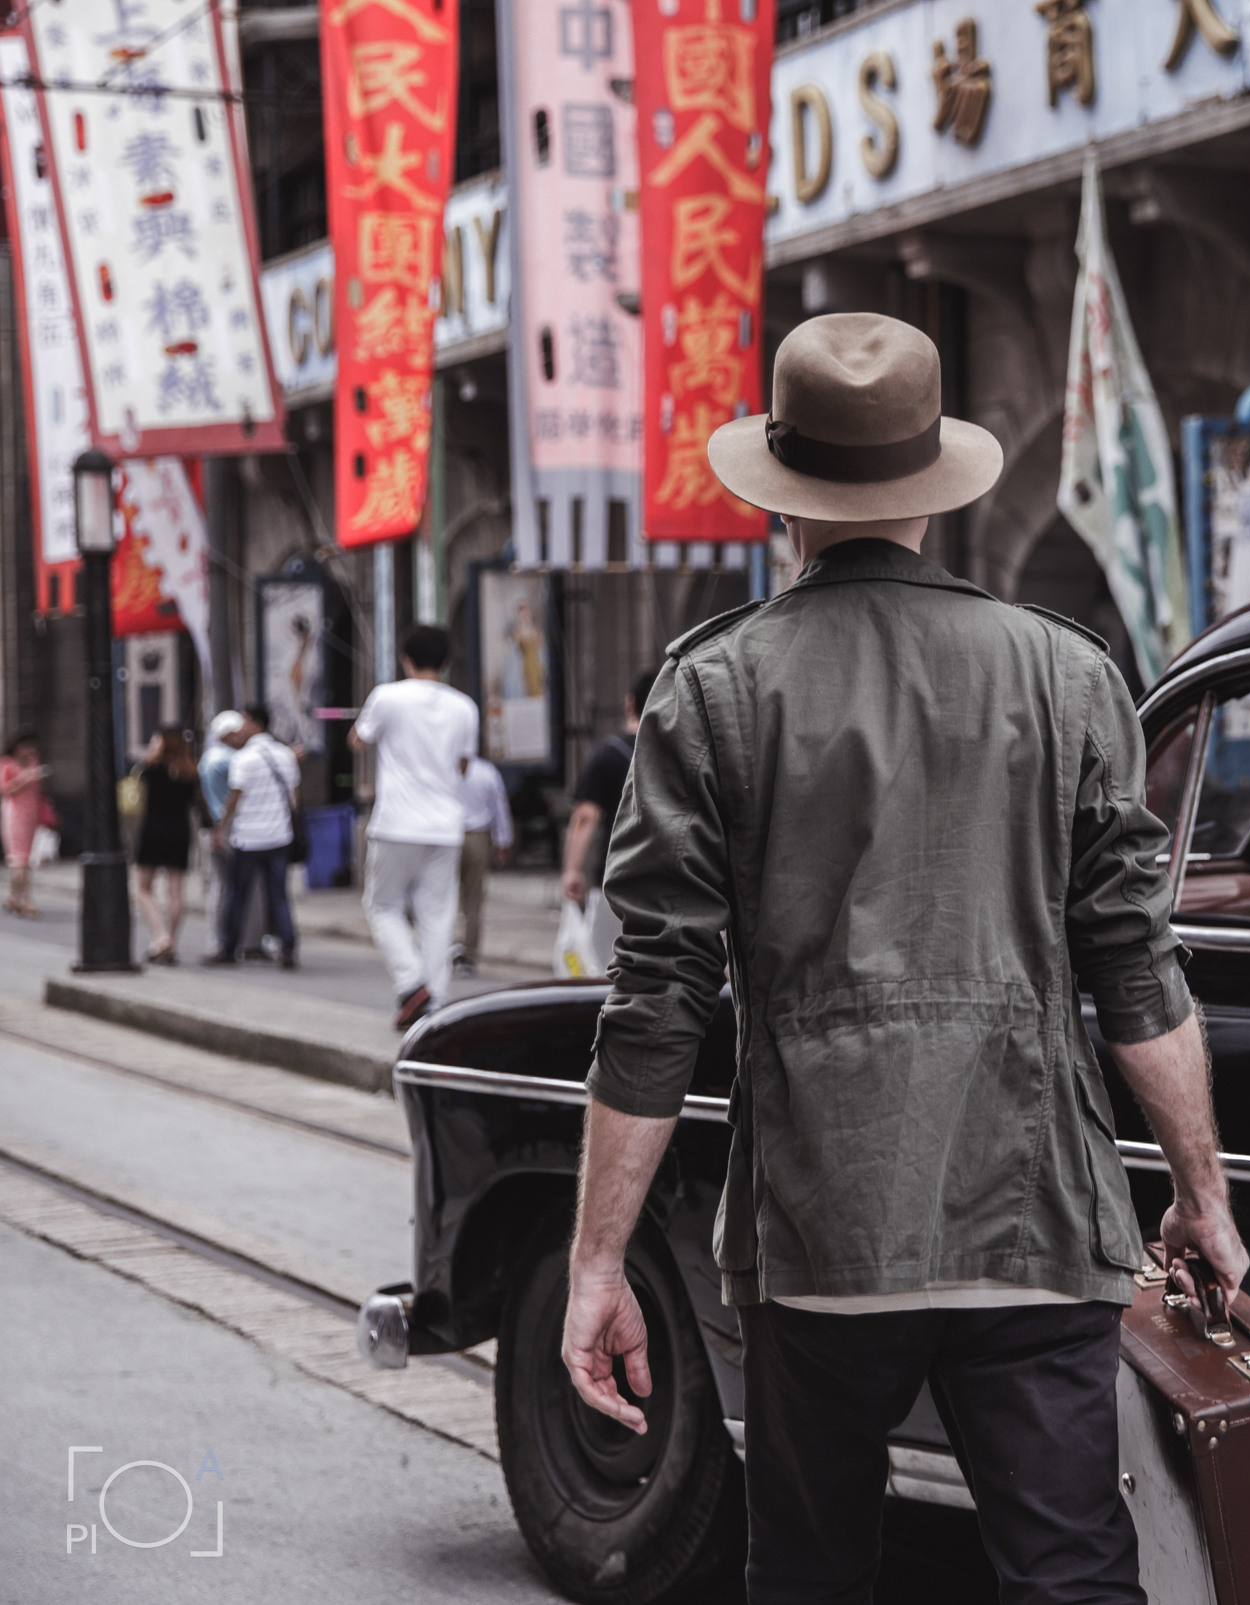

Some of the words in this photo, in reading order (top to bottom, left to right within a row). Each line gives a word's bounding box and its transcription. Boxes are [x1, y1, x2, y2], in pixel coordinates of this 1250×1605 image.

[647, 0, 767, 519] 國人民萬歲
